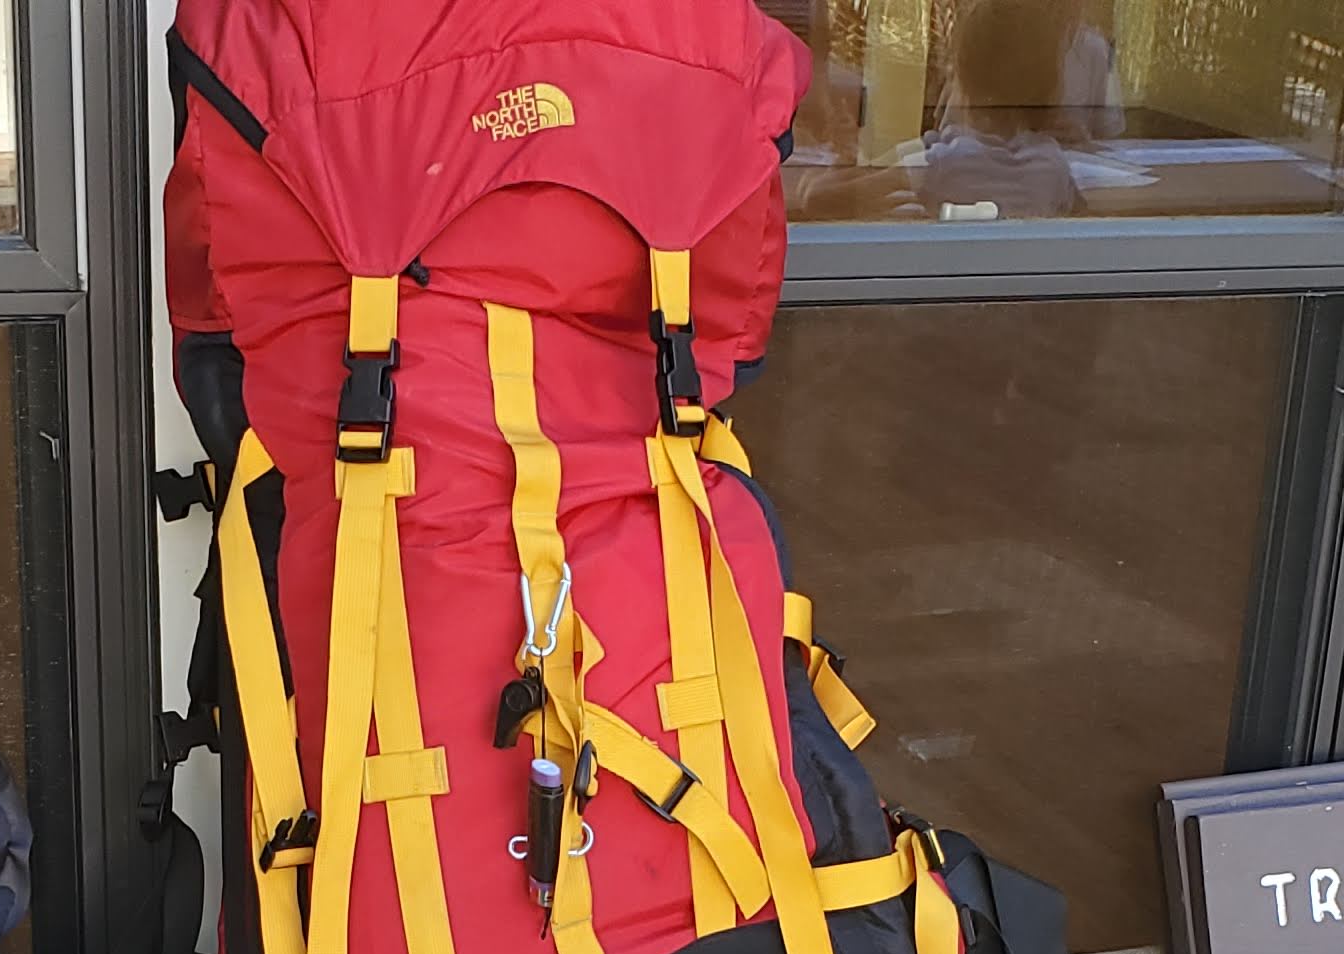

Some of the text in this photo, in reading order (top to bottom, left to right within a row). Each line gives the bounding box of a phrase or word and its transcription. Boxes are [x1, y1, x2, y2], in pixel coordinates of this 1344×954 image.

[496, 84, 534, 109] THE
[472, 98, 538, 132] NORTH
[491, 117, 540, 142] FACE
